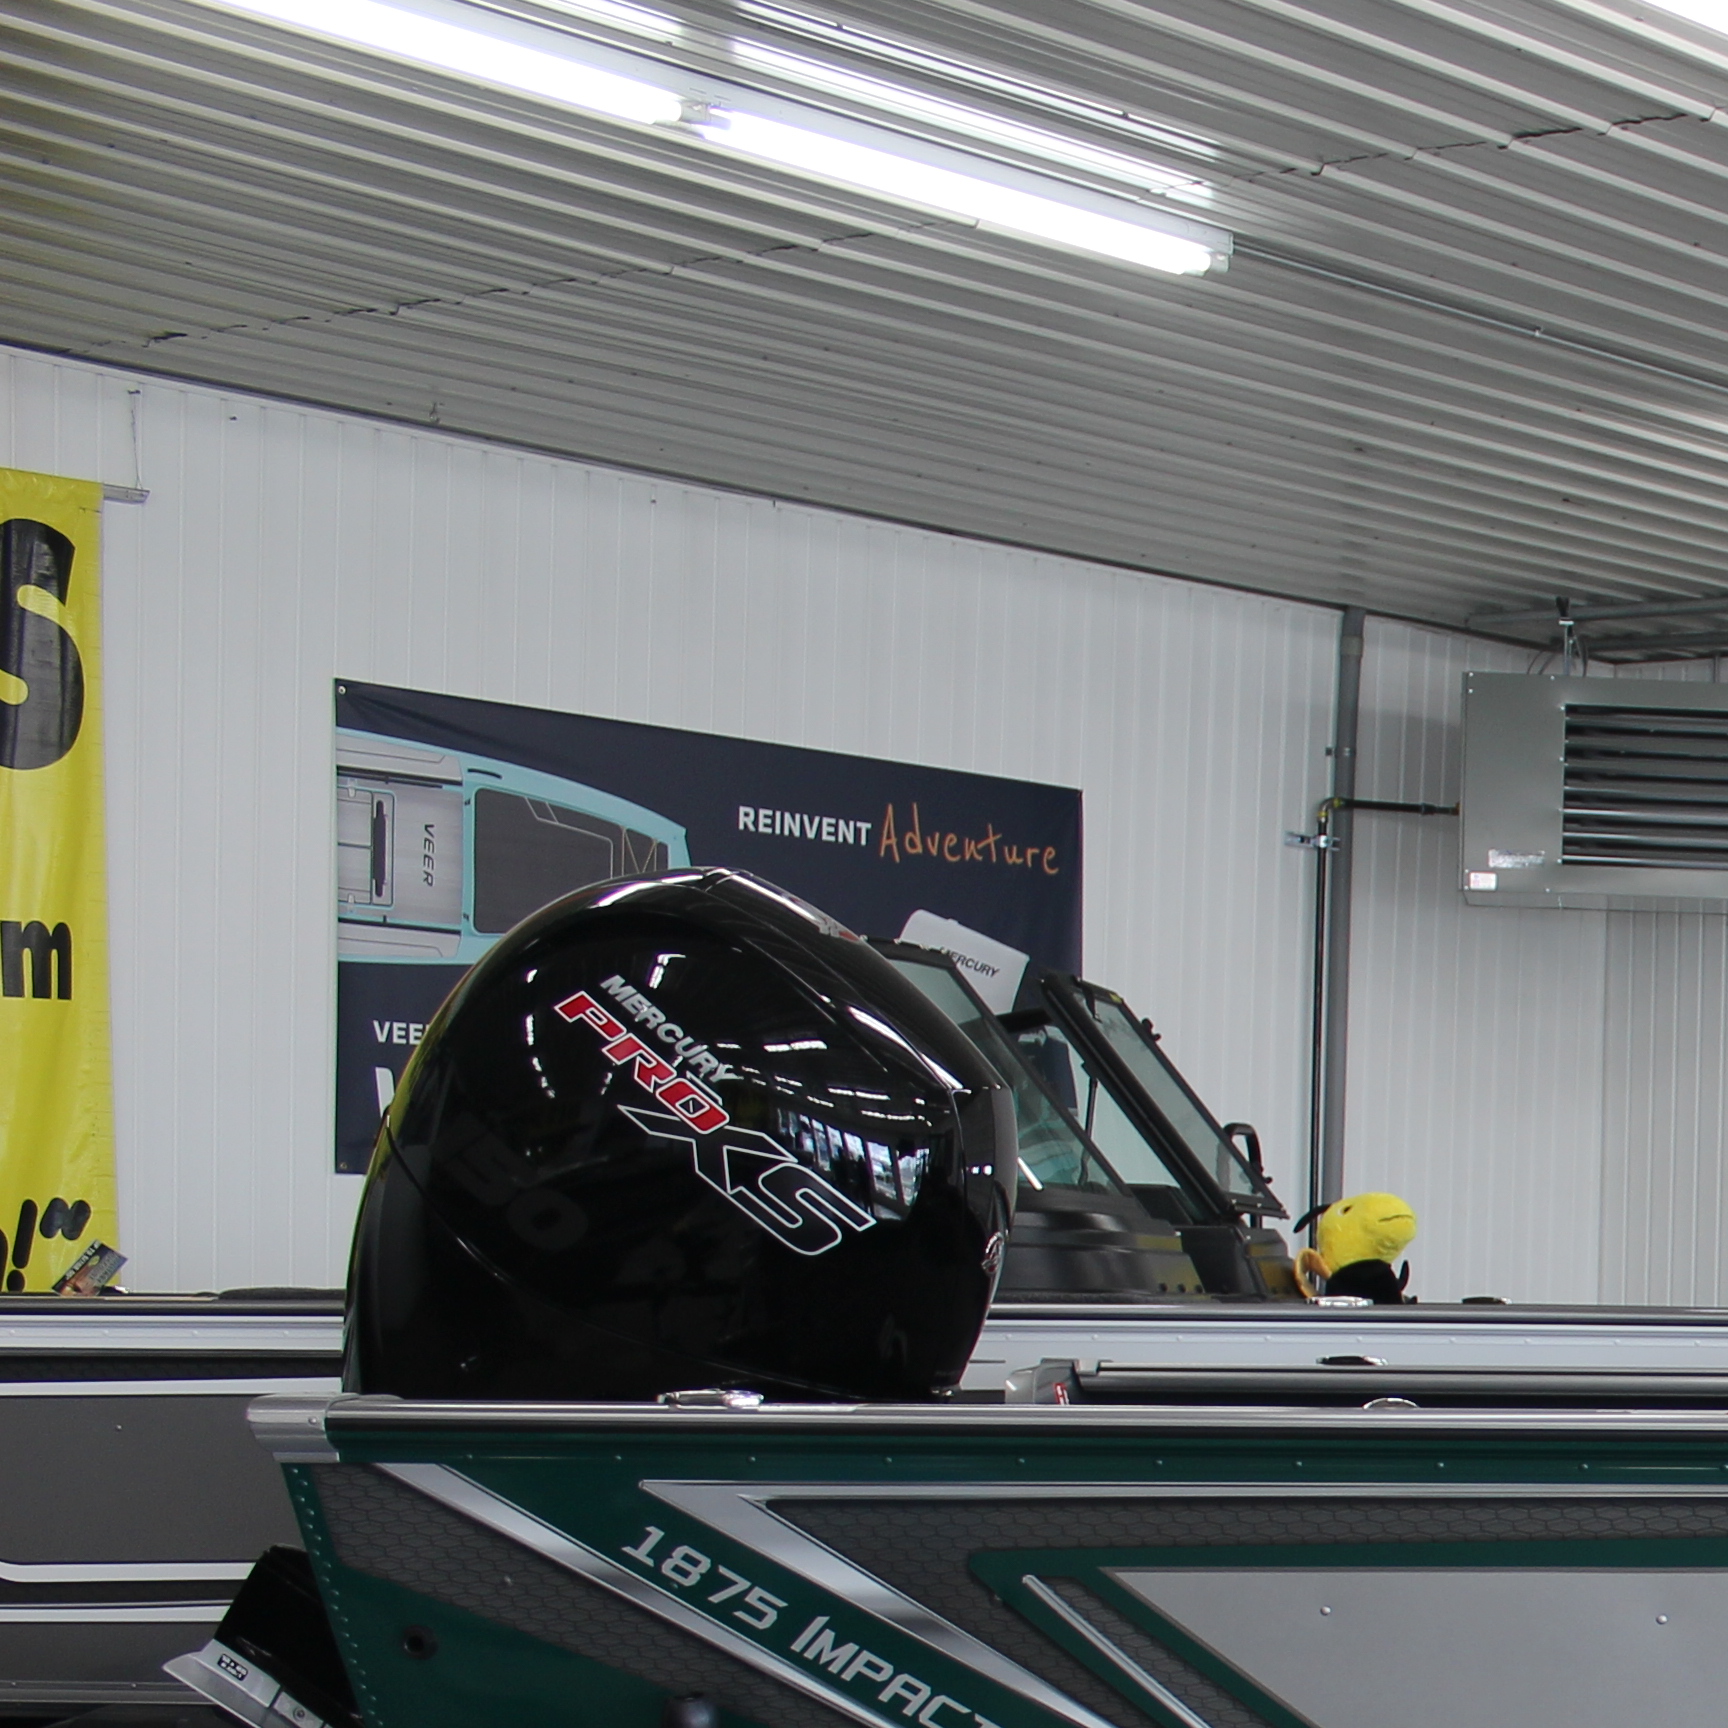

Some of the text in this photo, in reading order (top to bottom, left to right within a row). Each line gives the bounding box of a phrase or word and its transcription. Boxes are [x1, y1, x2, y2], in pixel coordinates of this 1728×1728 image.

[422, 823, 435, 887] VEER
[738, 802, 1059, 875] REINVENT Adventure
[373, 1020, 430, 1045] VEE
[553, 990, 730, 1134] PRO
[600, 974, 743, 1083] MERCURY
[621, 1526, 788, 1630] 1875
